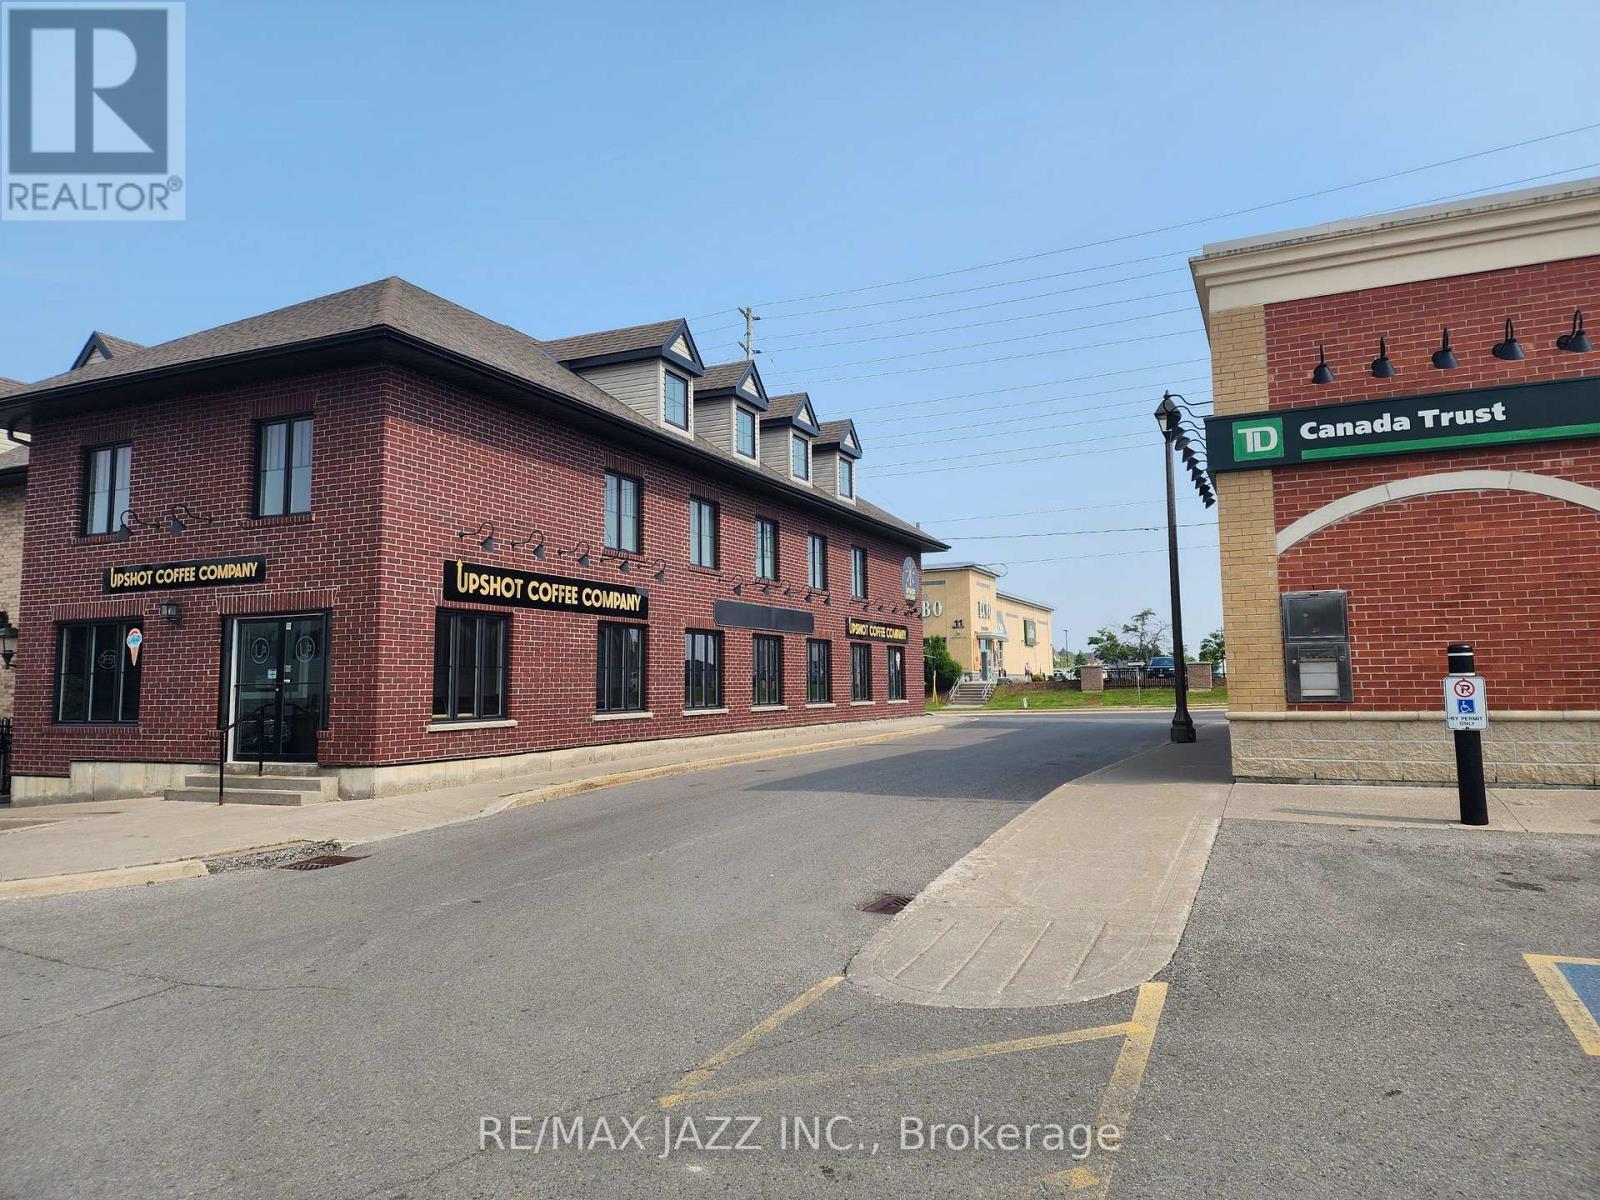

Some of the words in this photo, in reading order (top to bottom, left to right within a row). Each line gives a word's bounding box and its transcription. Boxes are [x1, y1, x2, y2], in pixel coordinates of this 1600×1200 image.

[1300, 412, 1411, 440] Canada
[1417, 401, 1507, 428] Trust
[1237, 426, 1278, 453] TD
[110, 567, 153, 588] UPSHOT
[155, 567, 196, 584] COFFEE
[199, 562, 258, 581] COMPANY
[456, 557, 524, 599] UPSHOT
[527, 580, 579, 605] COFFEE
[582, 587, 642, 612] COMPANY
